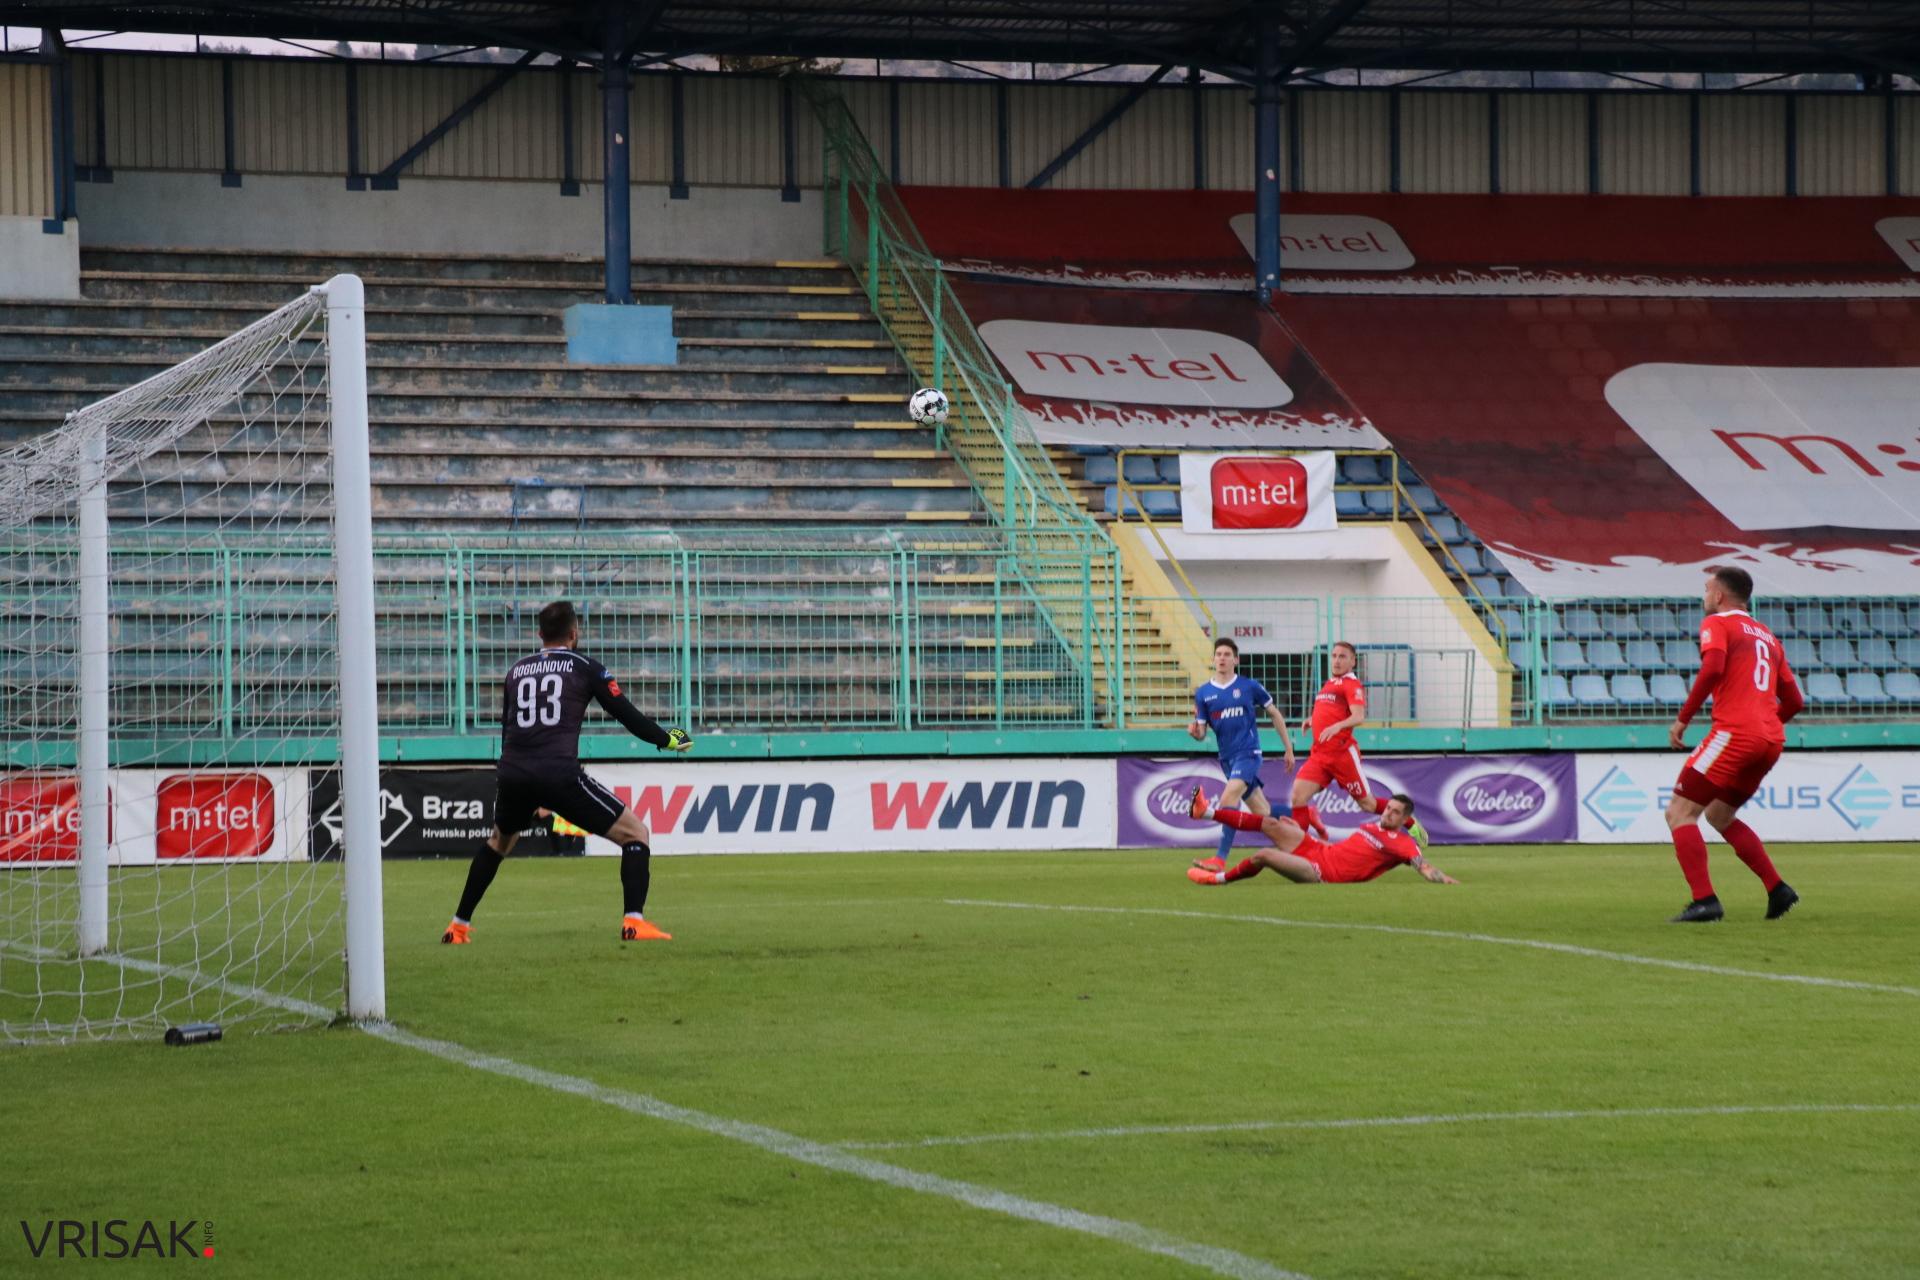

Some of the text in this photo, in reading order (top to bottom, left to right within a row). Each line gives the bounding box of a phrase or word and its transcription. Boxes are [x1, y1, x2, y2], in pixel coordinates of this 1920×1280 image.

[1025, 350, 1248, 384] m:tel
[1221, 477, 1298, 508] m:tel
[1234, 626, 1264, 637] EXIT
[512, 658, 574, 680] BOGDANOVIĆ
[1754, 639, 1771, 692] 6
[516, 673, 563, 728] 93
[1346, 781, 1362, 795] 23
[1463, 785, 1536, 812] Violeta
[4, 801, 81, 834] m:te
[169, 796, 260, 832] m:tel
[422, 795, 484, 820] Brza
[422, 827, 466, 838] Hrvatska
